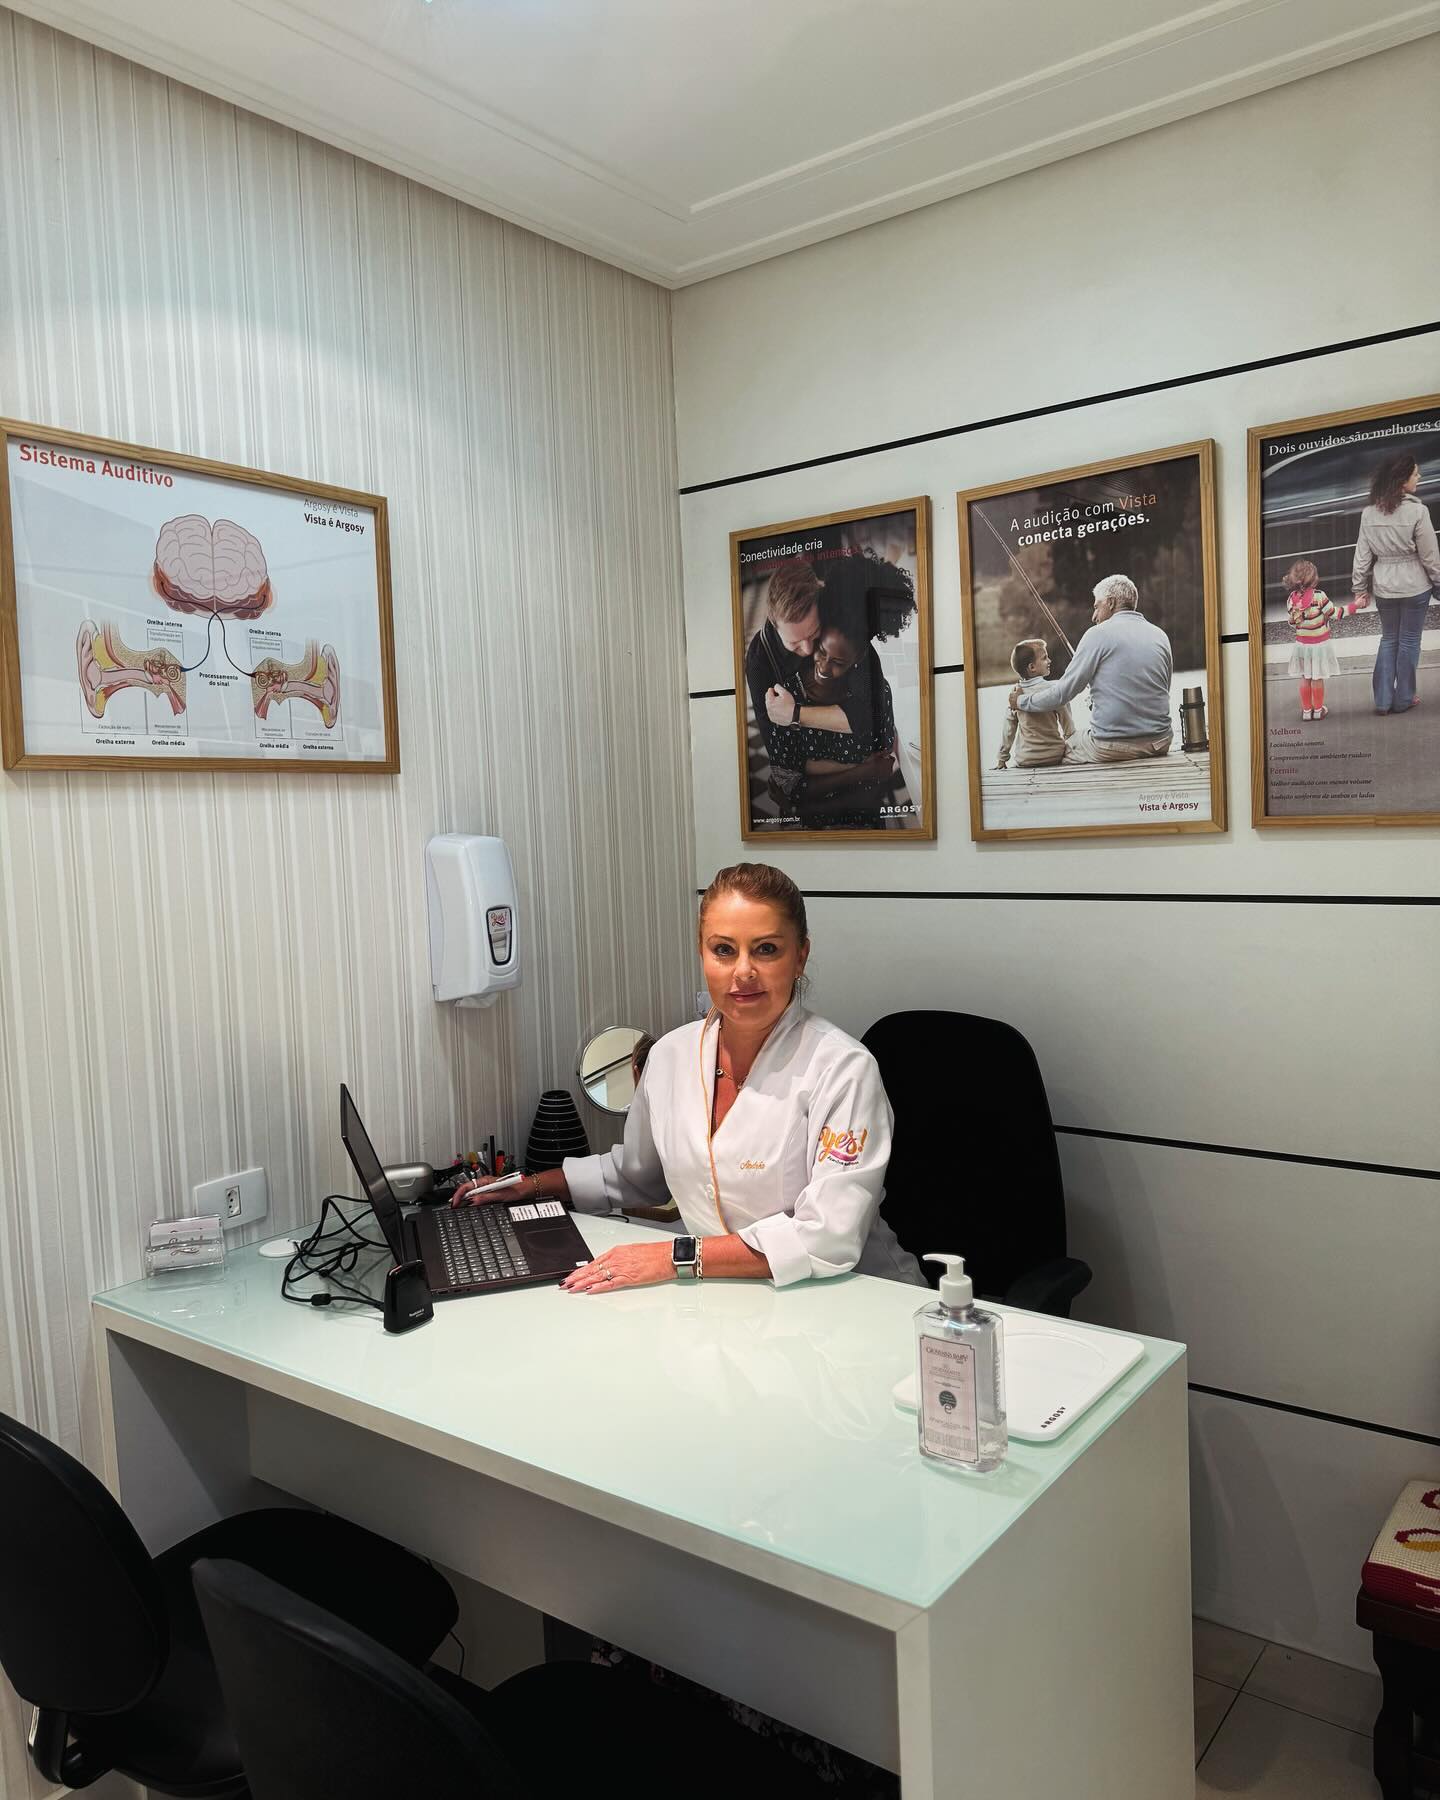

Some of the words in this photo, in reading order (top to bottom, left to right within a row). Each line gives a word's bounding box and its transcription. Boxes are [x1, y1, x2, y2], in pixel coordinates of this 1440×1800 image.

[1268, 443, 1296, 456] Dois
[1298, 435, 1346, 452] ouvidos
[1349, 431, 1369, 443] são
[1371, 420, 1431, 438] melhores
[19, 443, 96, 474] Sistema
[101, 460, 173, 488] Auditivo
[303, 499, 331, 514] Argosy
[1010, 518, 1020, 532] A
[1023, 507, 1080, 529] audição
[1084, 501, 1114, 517] com
[1119, 493, 1157, 510] Vista
[304, 512, 327, 526] Vista
[328, 517, 334, 528] é
[335, 519, 365, 535] Argosy
[1017, 525, 1073, 547] conecta
[1077, 512, 1151, 539] gerações.
[740, 542, 803, 563] Conectividade
[804, 538, 823, 551] cria
[1270, 727, 1302, 736] Melhora
[879, 804, 922, 814] ARGOSY
[1138, 803, 1160, 812] Vista
[1162, 801, 1168, 811] é
[1168, 801, 1199, 811] Argosy
[752, 815, 801, 825] www.argosy.com.br
